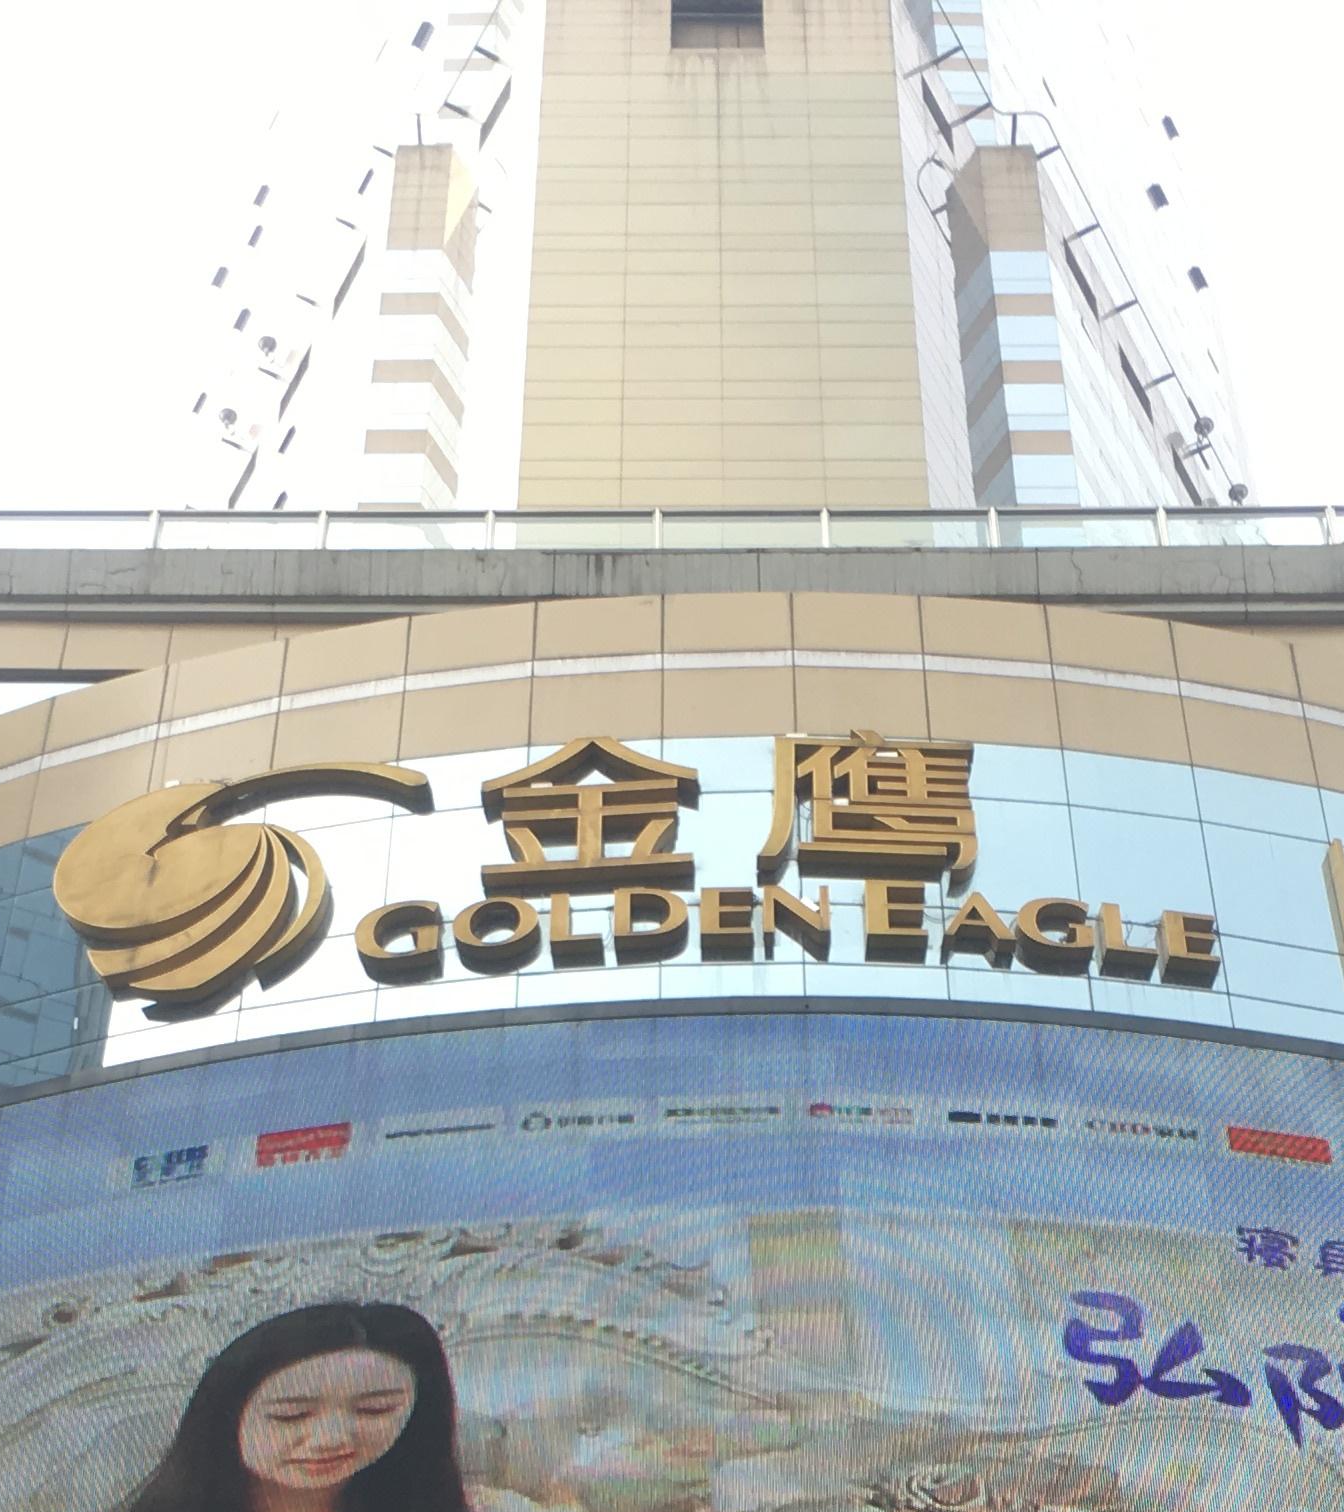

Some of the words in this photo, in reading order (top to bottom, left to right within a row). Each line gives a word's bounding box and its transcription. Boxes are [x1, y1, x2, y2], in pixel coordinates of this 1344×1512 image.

[480, 728, 980, 898] 金鹰
[356, 883, 832, 985] GOLDEN
[862, 878, 1223, 990] EAGLE
